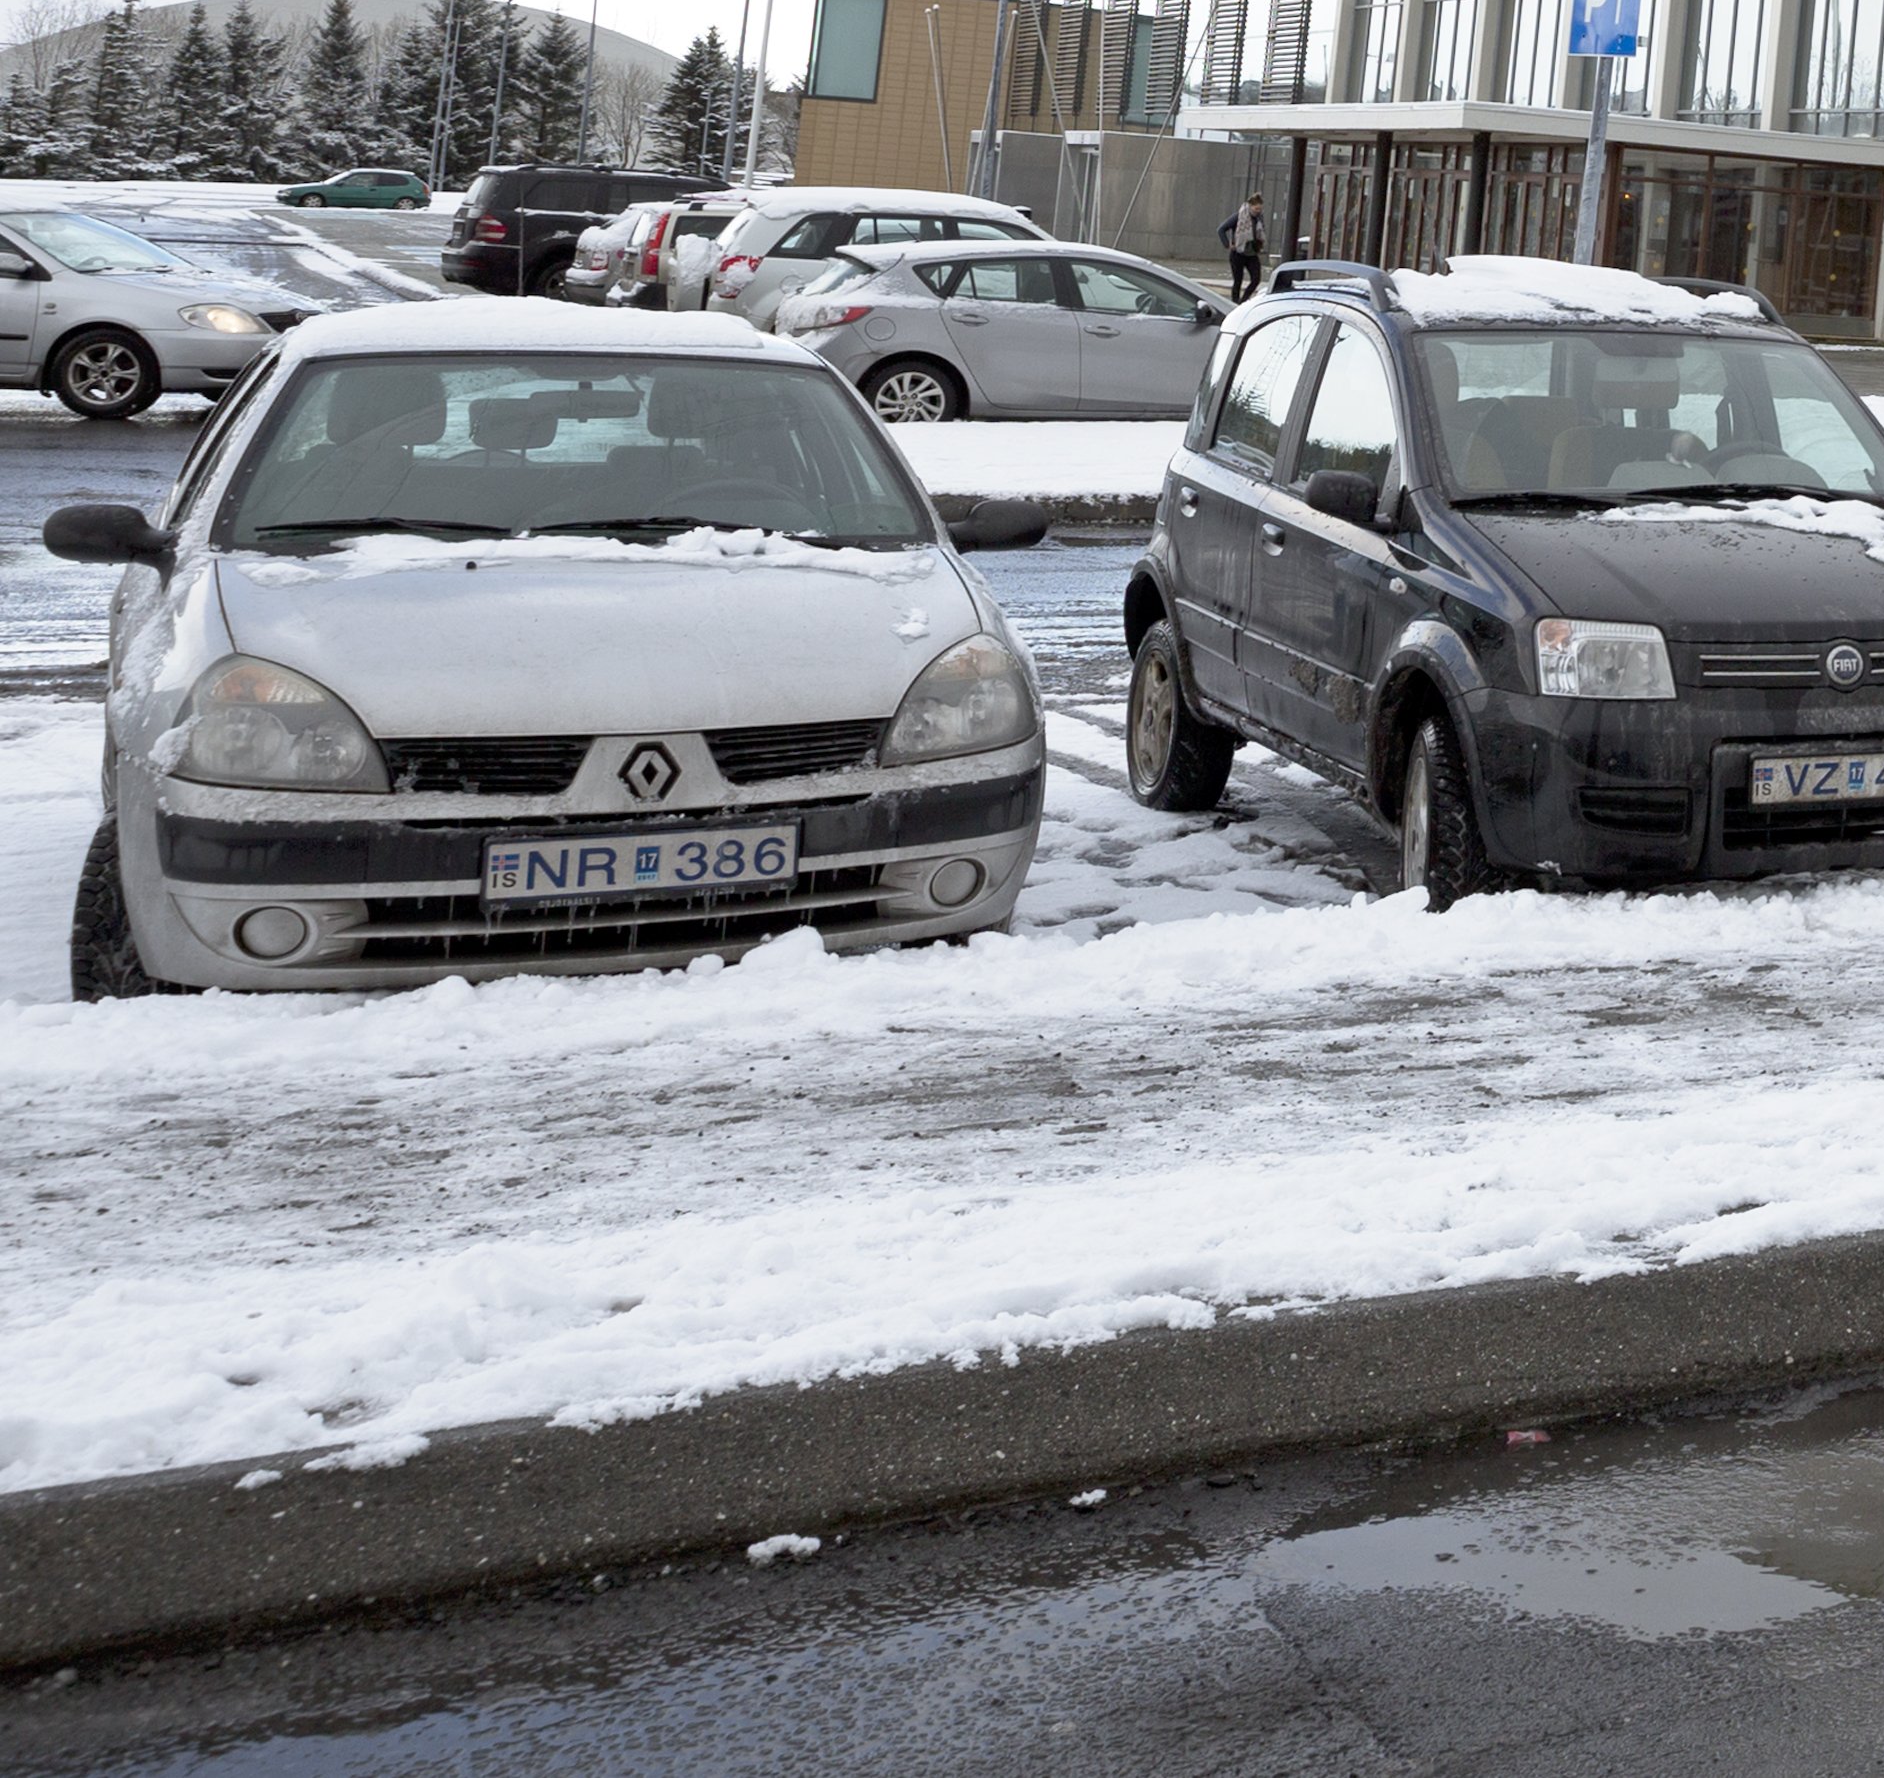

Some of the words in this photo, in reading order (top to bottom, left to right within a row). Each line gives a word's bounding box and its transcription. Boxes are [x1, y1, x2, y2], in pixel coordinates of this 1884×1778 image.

[1833, 658, 1857, 672] FIAT
[1784, 762, 1840, 796] VZ
[1851, 767, 1864, 780] 17
[1755, 782, 1772, 796] IS
[526, 847, 617, 890] NR
[639, 853, 658, 869] 17
[675, 837, 786, 881] 386
[492, 872, 517, 889] IS
